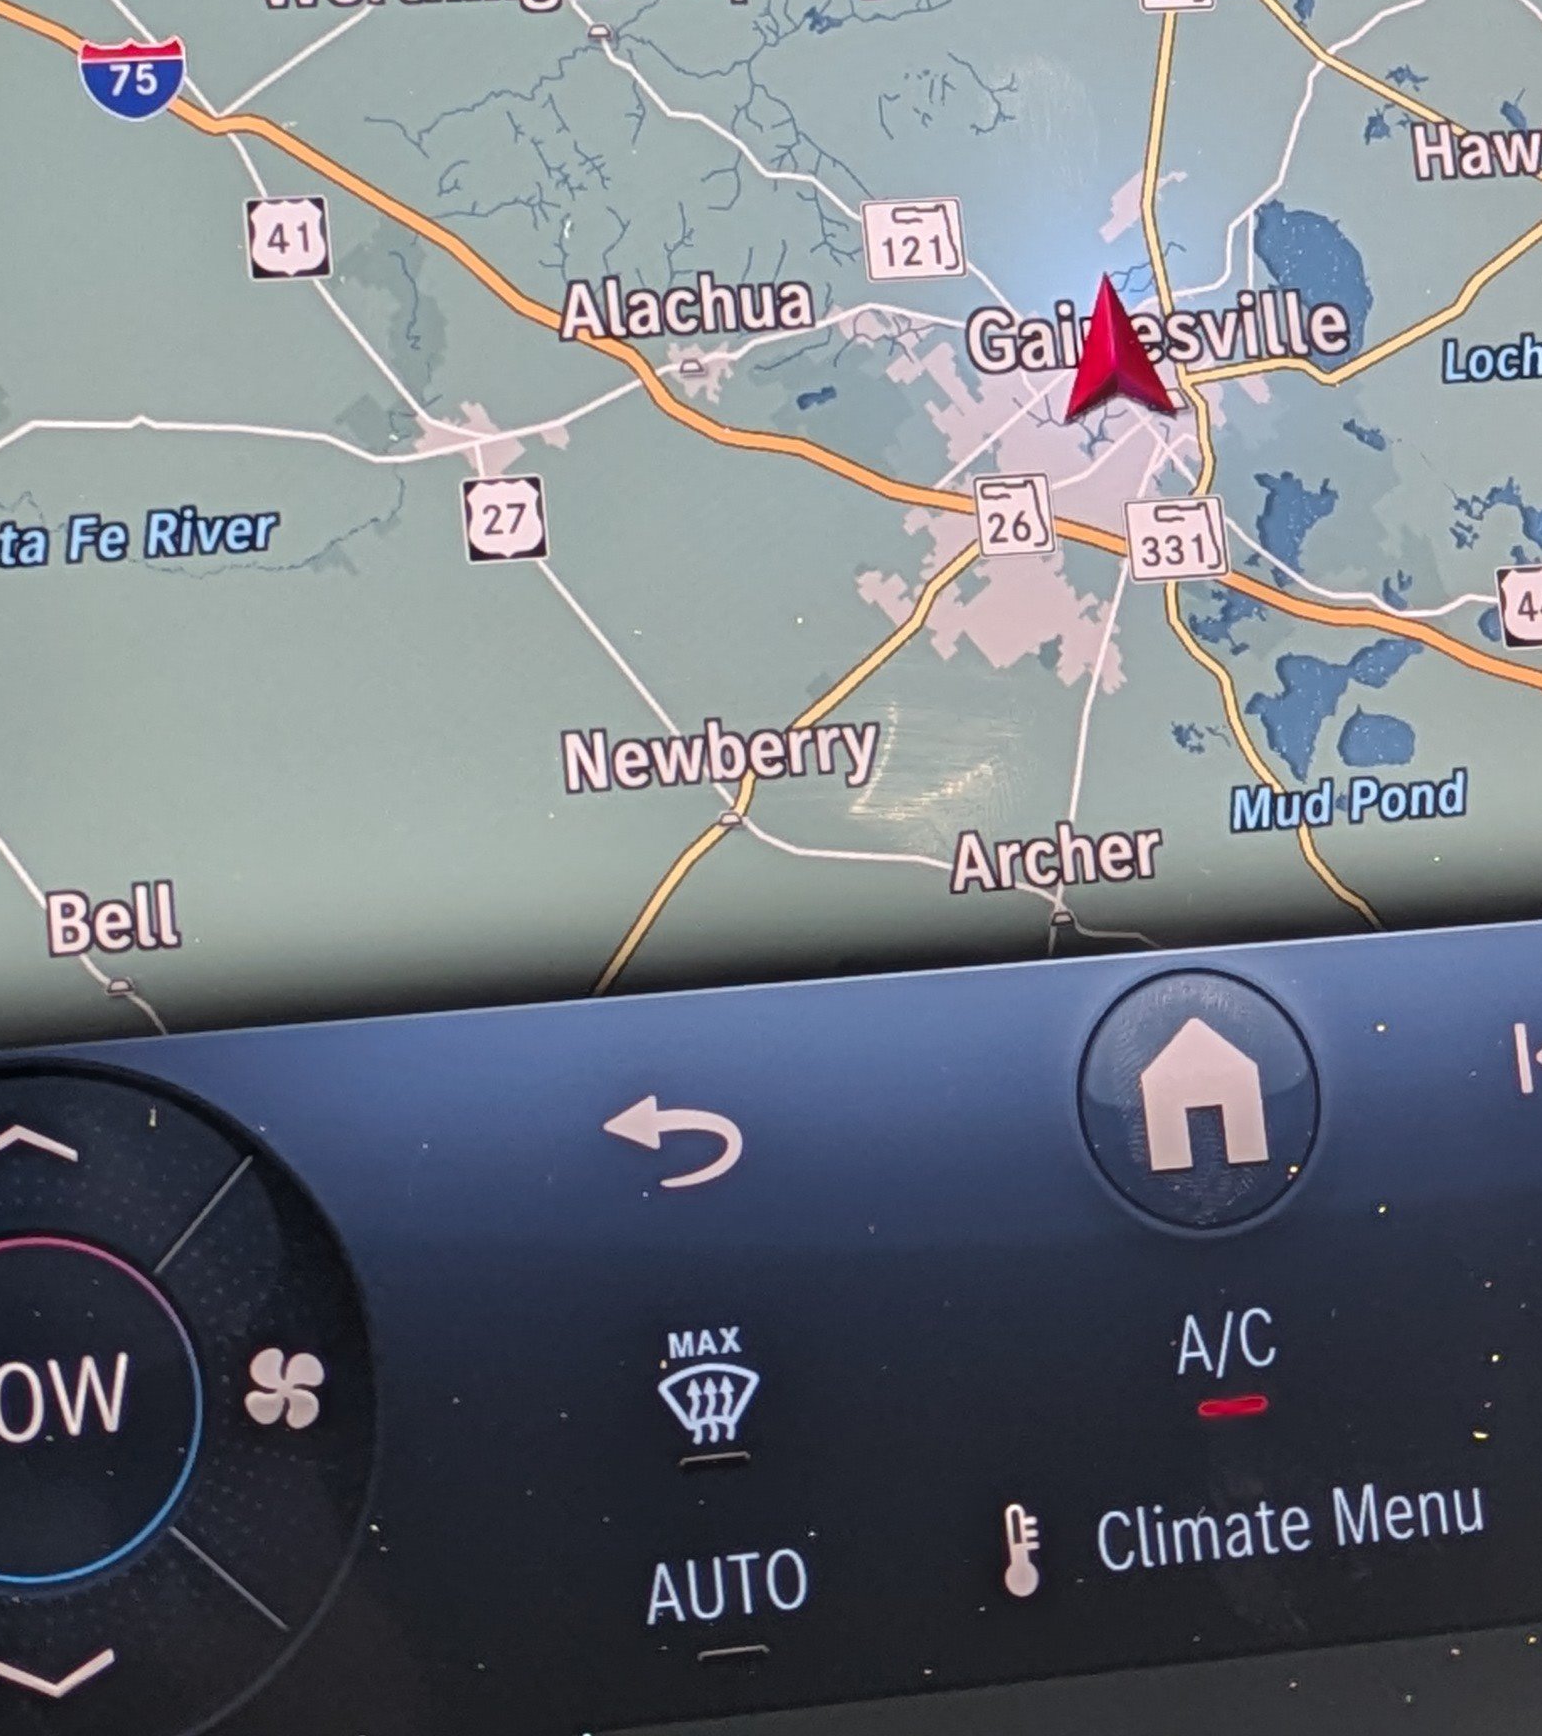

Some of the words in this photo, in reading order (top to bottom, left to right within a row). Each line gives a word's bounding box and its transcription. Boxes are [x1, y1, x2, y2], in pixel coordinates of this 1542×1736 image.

[109, 65, 158, 99] 75
[267, 222, 311, 256] 41
[879, 233, 945, 268] 121
[559, 273, 816, 340] Alachua
[63, 514, 130, 563] Fe
[141, 506, 280, 561] River
[481, 502, 527, 538] 27
[985, 512, 1036, 546] 26
[1137, 532, 1210, 569] 331
[561, 717, 881, 792] Newberry
[1230, 784, 1334, 832] Mud
[1348, 771, 1469, 820] Pond
[949, 826, 1163, 896] Archer
[44, 881, 182, 959] Bell
[667, 1324, 743, 1359] MAX
[1175, 1307, 1278, 1377] A/C
[1096, 1493, 1309, 1577] Climate
[1331, 1485, 1486, 1550] Menu
[646, 1549, 810, 1625] AUTO
